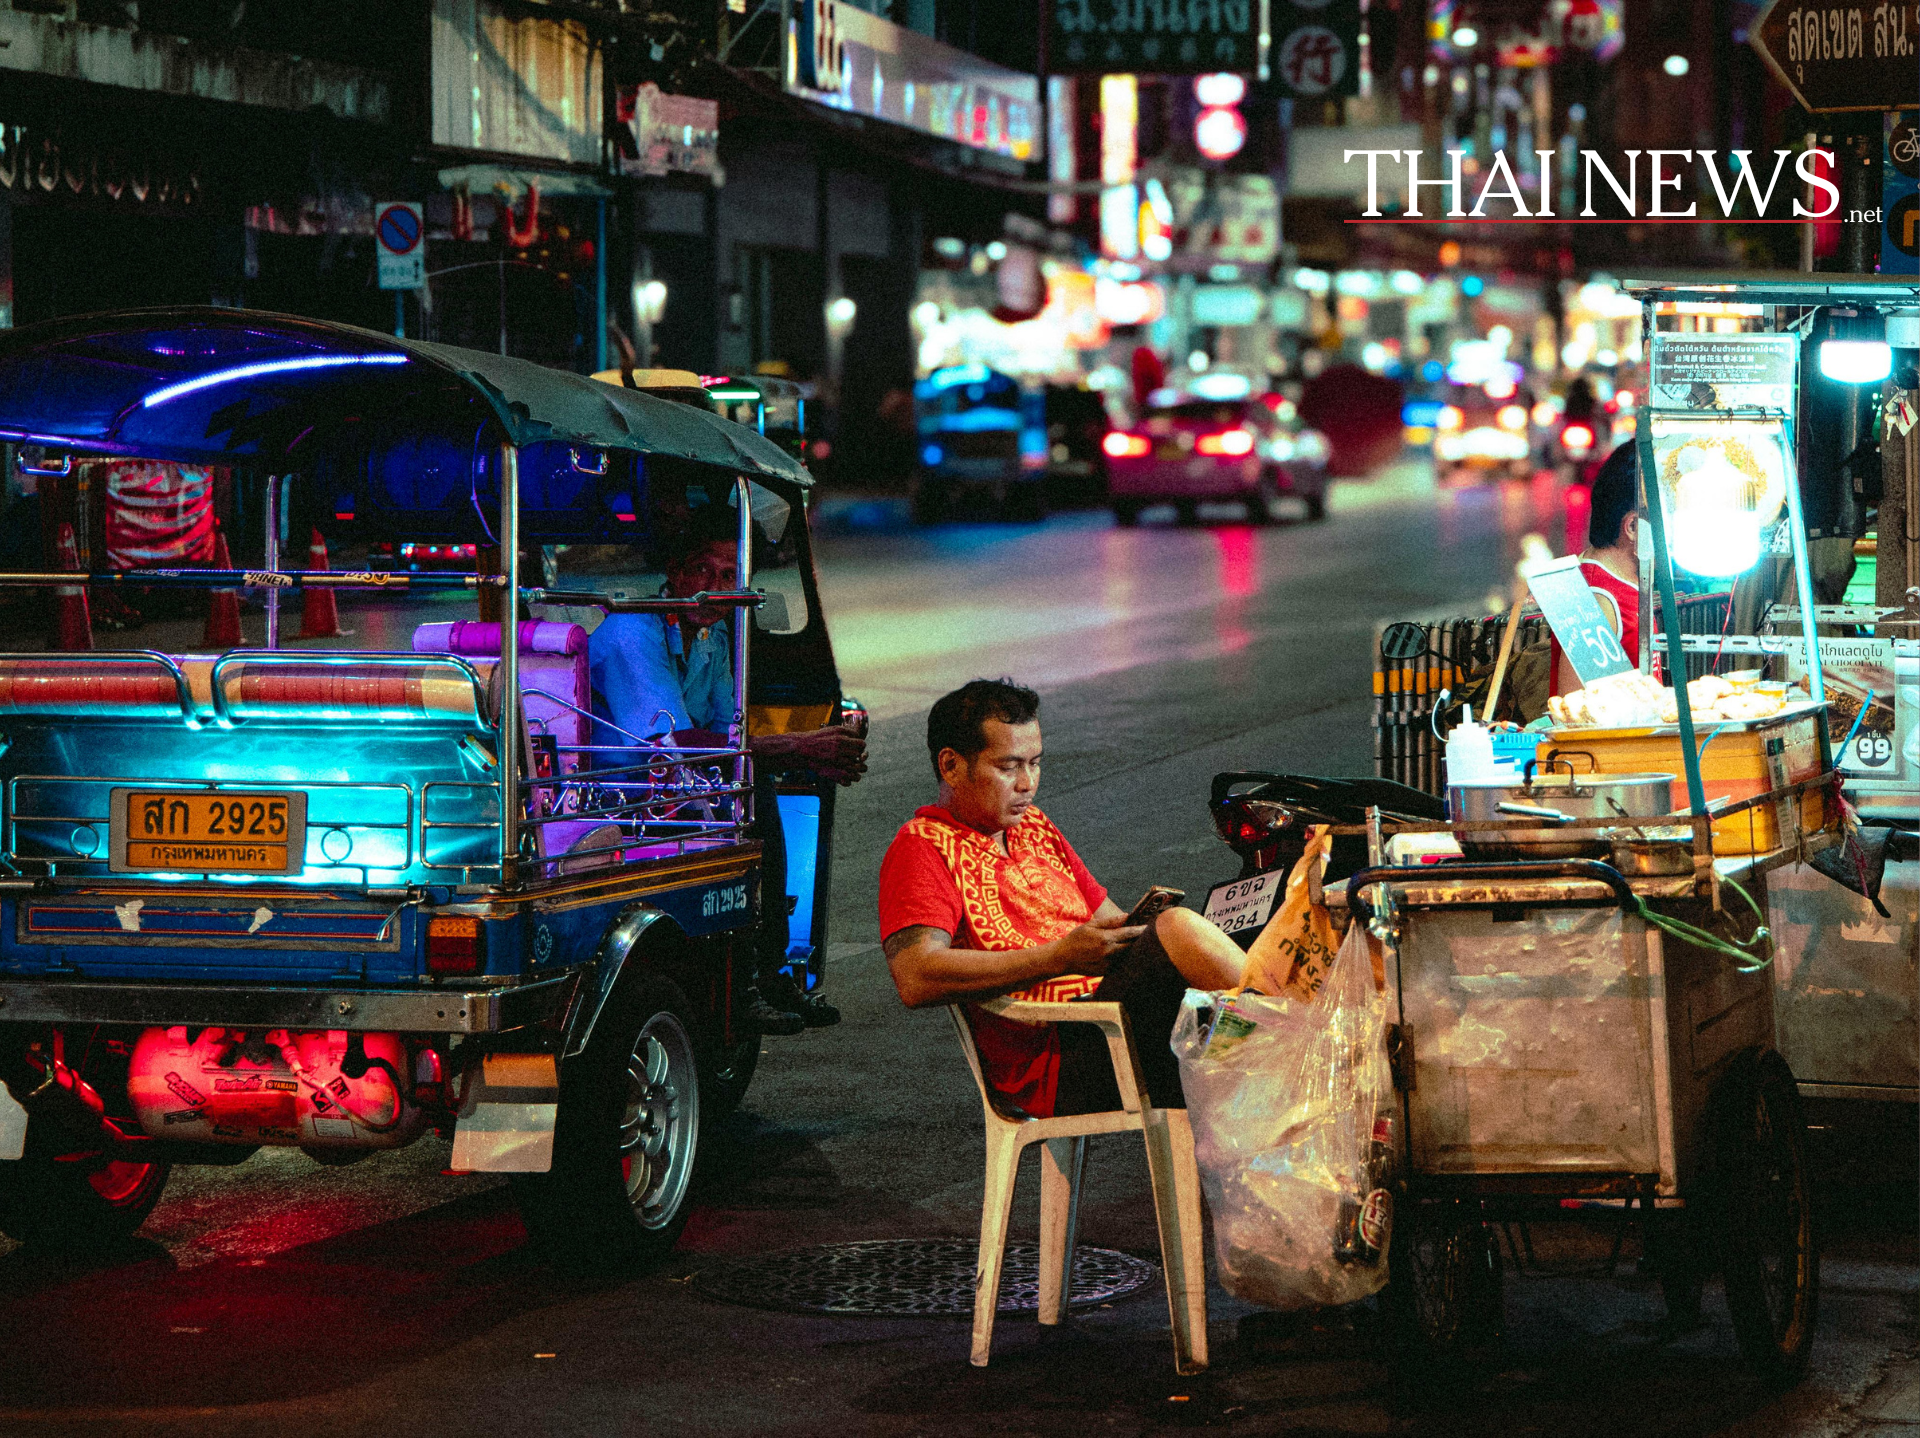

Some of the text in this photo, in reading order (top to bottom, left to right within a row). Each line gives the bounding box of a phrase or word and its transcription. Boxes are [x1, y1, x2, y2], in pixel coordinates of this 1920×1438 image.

[1788, 2, 1920, 85] สุดเขต สน.
[1858, 738, 1890, 759] 99
[144, 797, 286, 835] สก 2925
[151, 846, 266, 865] กรุงเทพมหานคร
[720, 884, 747, 912] 2925
[1215, 910, 1258, 933] 284
[274, 1082, 297, 1091] YAMAHA
